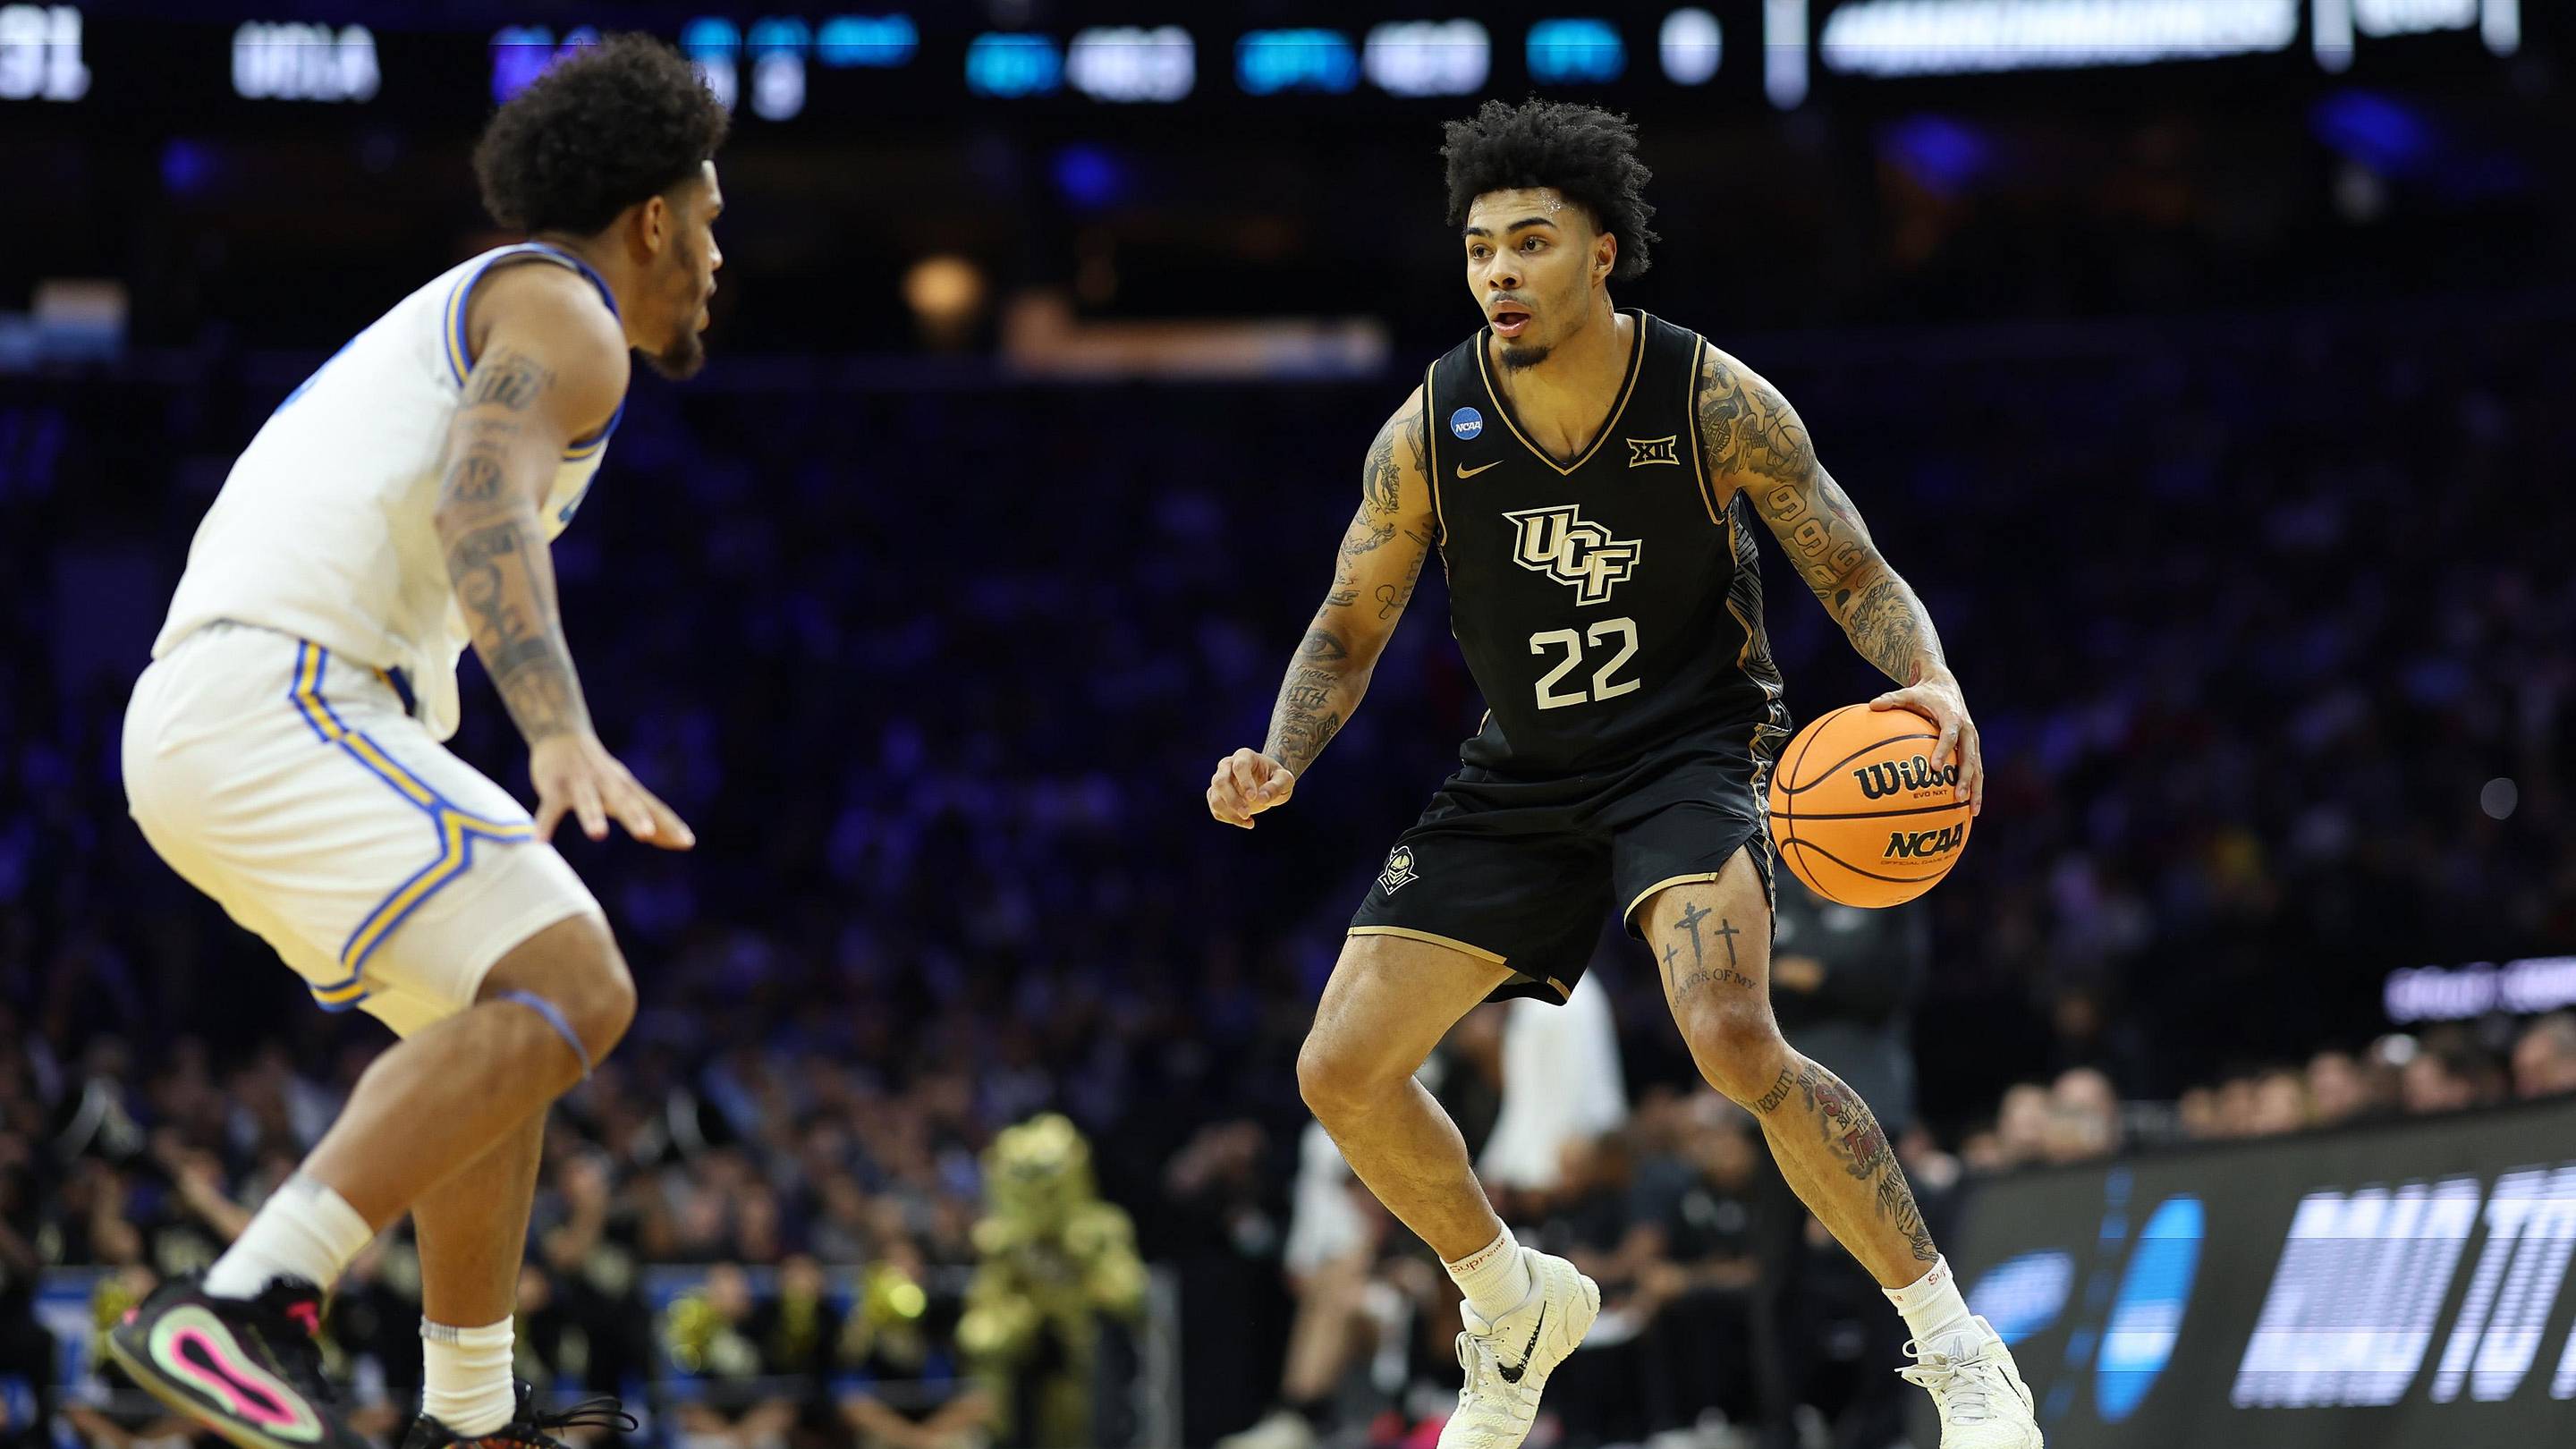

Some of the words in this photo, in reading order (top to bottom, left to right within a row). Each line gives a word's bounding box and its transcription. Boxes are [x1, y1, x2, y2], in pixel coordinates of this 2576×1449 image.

[1455, 421, 1481, 433] NCAA
[1631, 439, 1675, 464] XII
[1515, 508, 1637, 602] UCF
[1529, 616, 1640, 710] 22
[1852, 755, 1959, 800] Wilso
[1913, 791, 1931, 799] EVO
[1882, 823, 1963, 860] NCAA
[1713, 968, 1733, 981] OF
[1734, 972, 1757, 989] MY
[1757, 1064, 1793, 1114] REALITY
[1450, 1238, 1505, 1274] Supreme
